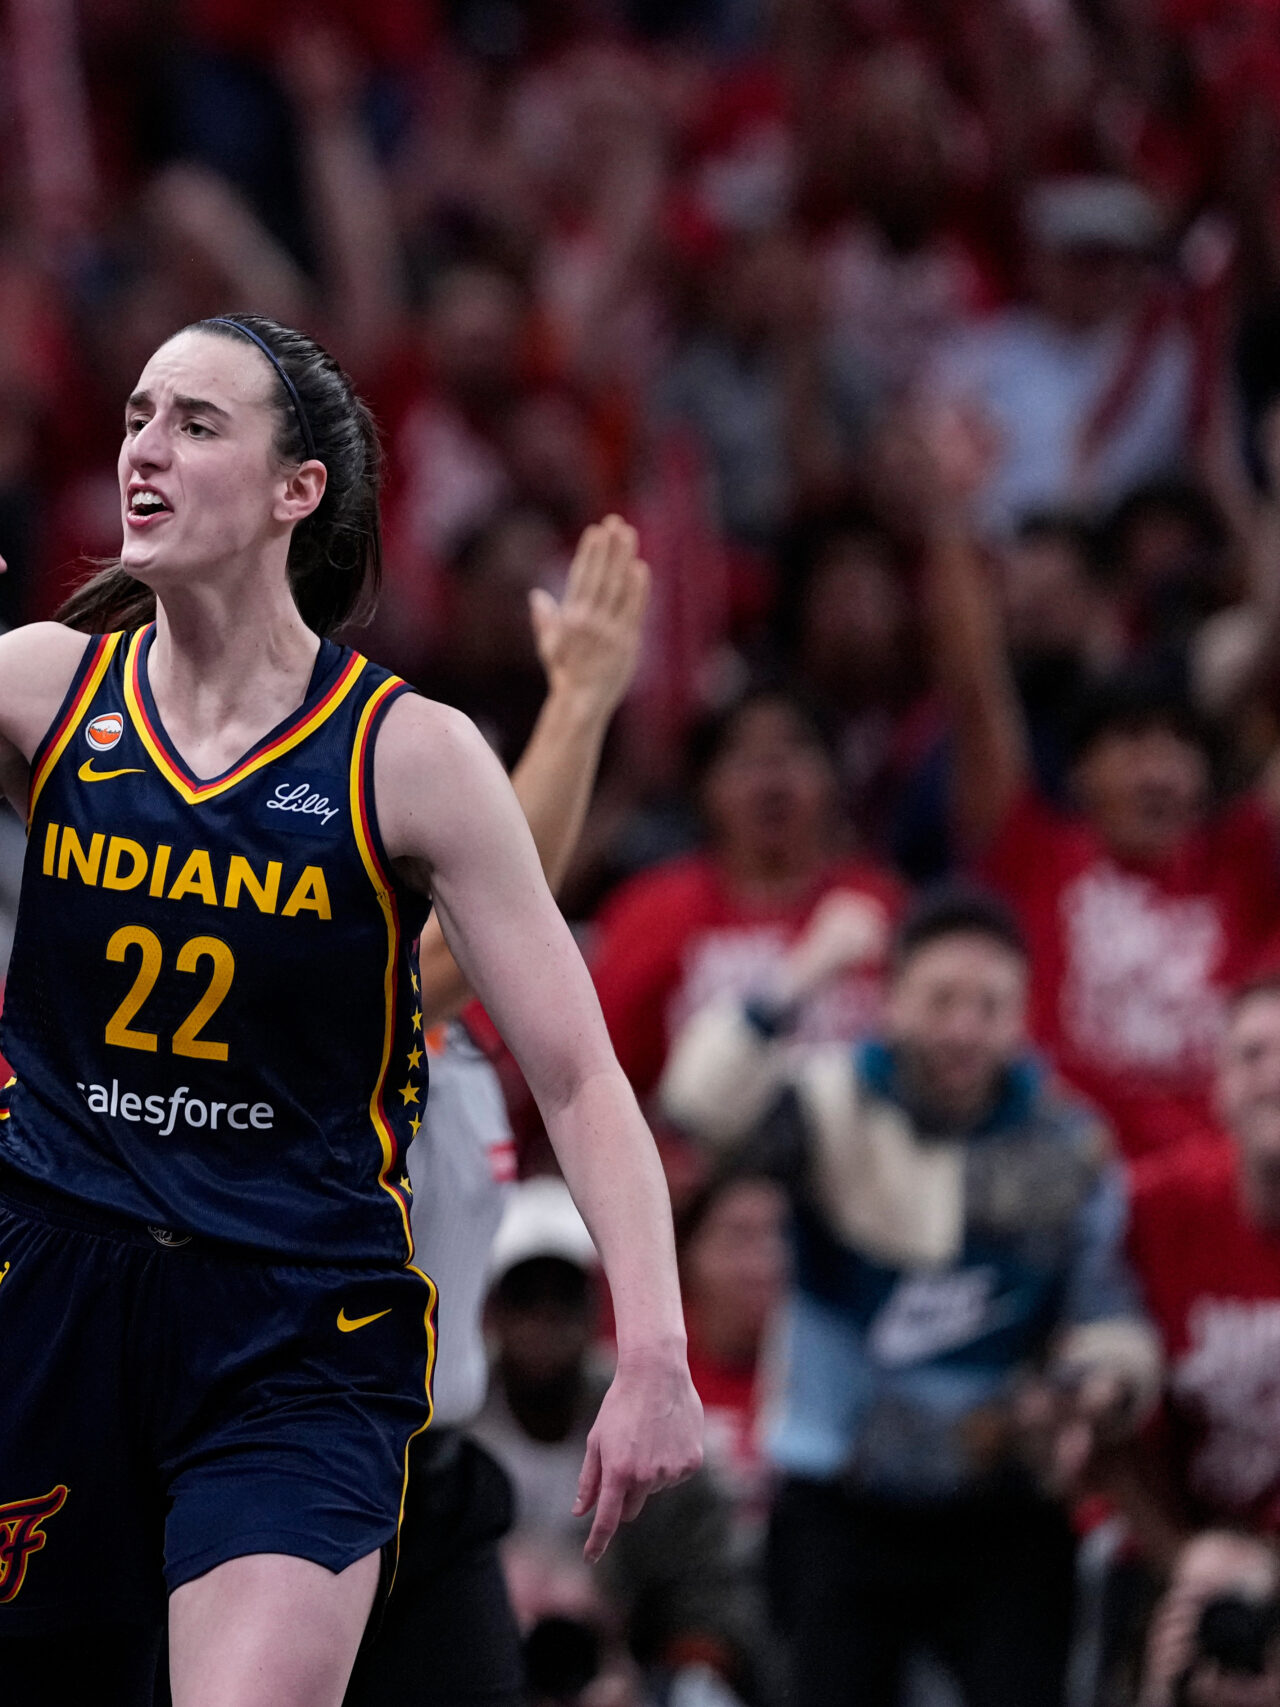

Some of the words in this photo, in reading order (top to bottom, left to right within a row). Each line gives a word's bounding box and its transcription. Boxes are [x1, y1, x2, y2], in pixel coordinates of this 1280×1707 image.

[266, 782, 340, 826] Lilly
[42, 822, 333, 921] INDIANA
[105, 924, 236, 1062] 22
